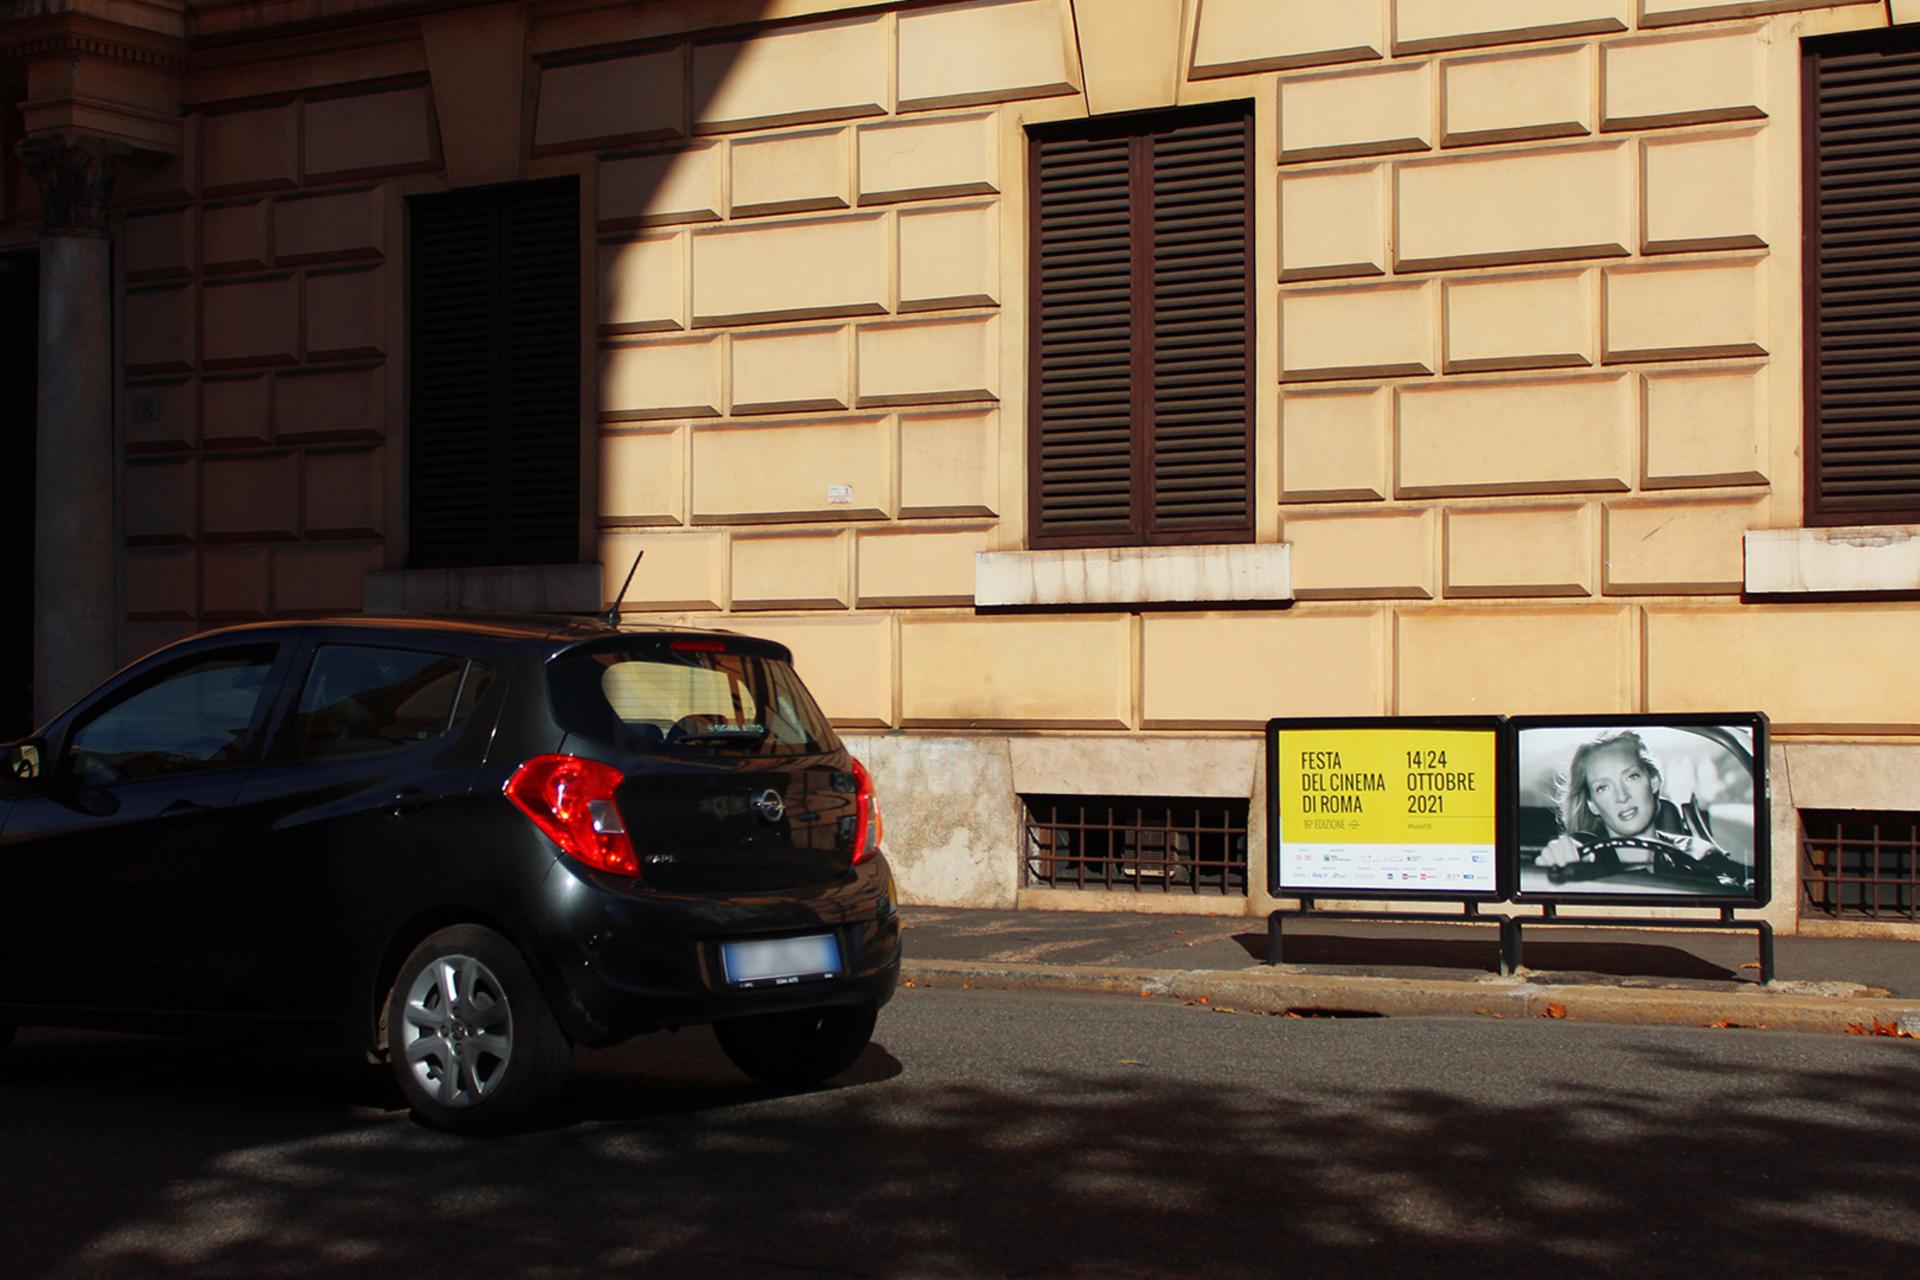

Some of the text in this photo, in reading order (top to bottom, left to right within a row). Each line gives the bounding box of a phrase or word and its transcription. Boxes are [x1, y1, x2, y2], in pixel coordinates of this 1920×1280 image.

[1301, 752, 1342, 769] FESTA
[1302, 773, 1386, 791] DEL CINEMA
[1407, 773, 1475, 791] OTTOBRE
[1303, 795, 1363, 813] DI ROMA
[1408, 795, 1443, 813] 2021
[1314, 820, 1345, 830] EDIZIONE
